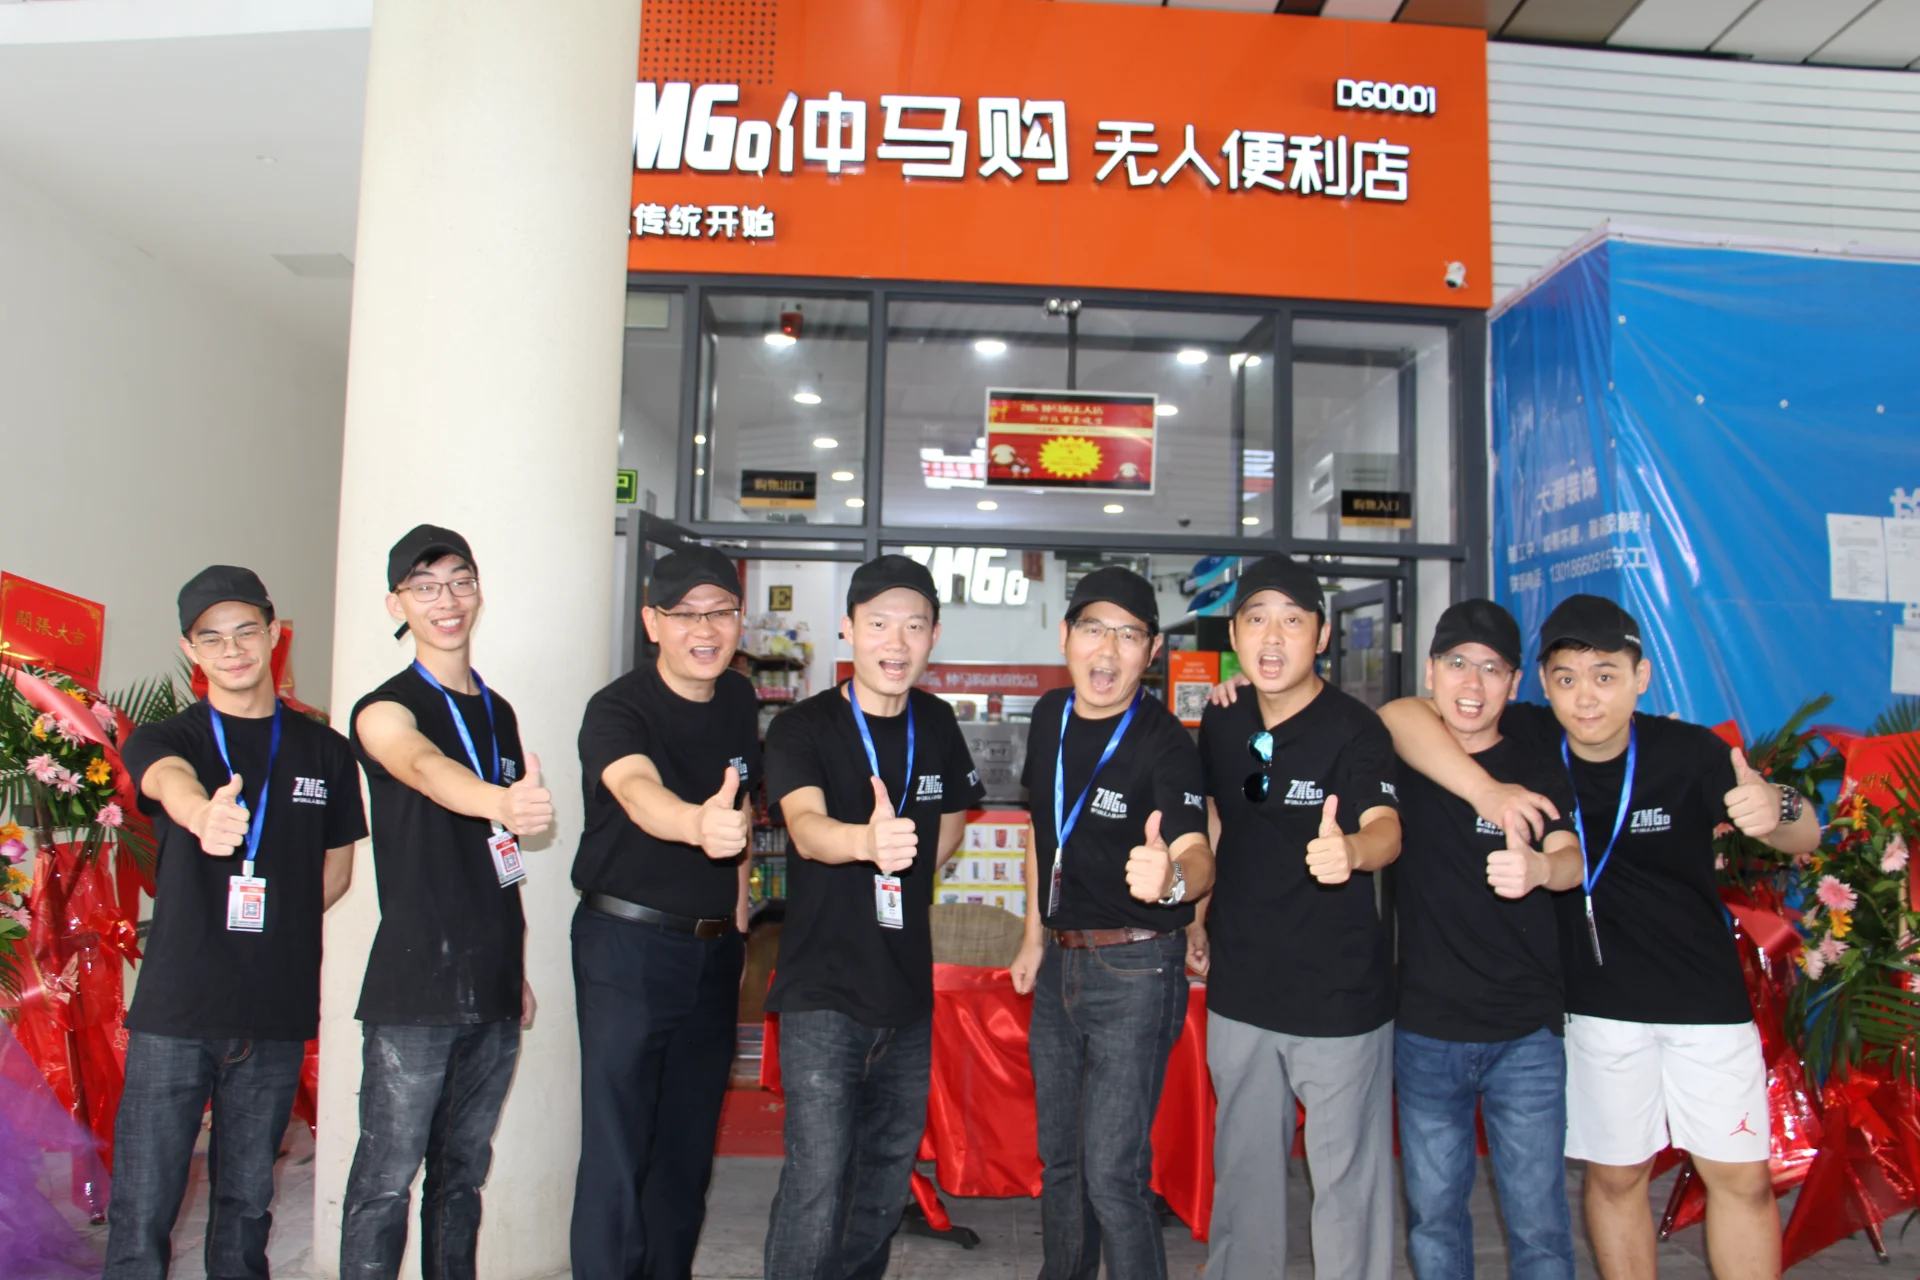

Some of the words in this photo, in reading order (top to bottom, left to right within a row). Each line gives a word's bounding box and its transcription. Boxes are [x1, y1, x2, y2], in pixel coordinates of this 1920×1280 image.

[775, 91, 1069, 181] 仲马购
[1094, 120, 1410, 201] 无人便利店
[628, 202, 775, 240] 传统开始
[1091, 787, 1128, 814] ZMGo
[1285, 779, 1324, 800] ZMGo
[1630, 807, 1671, 828] ZMGo
